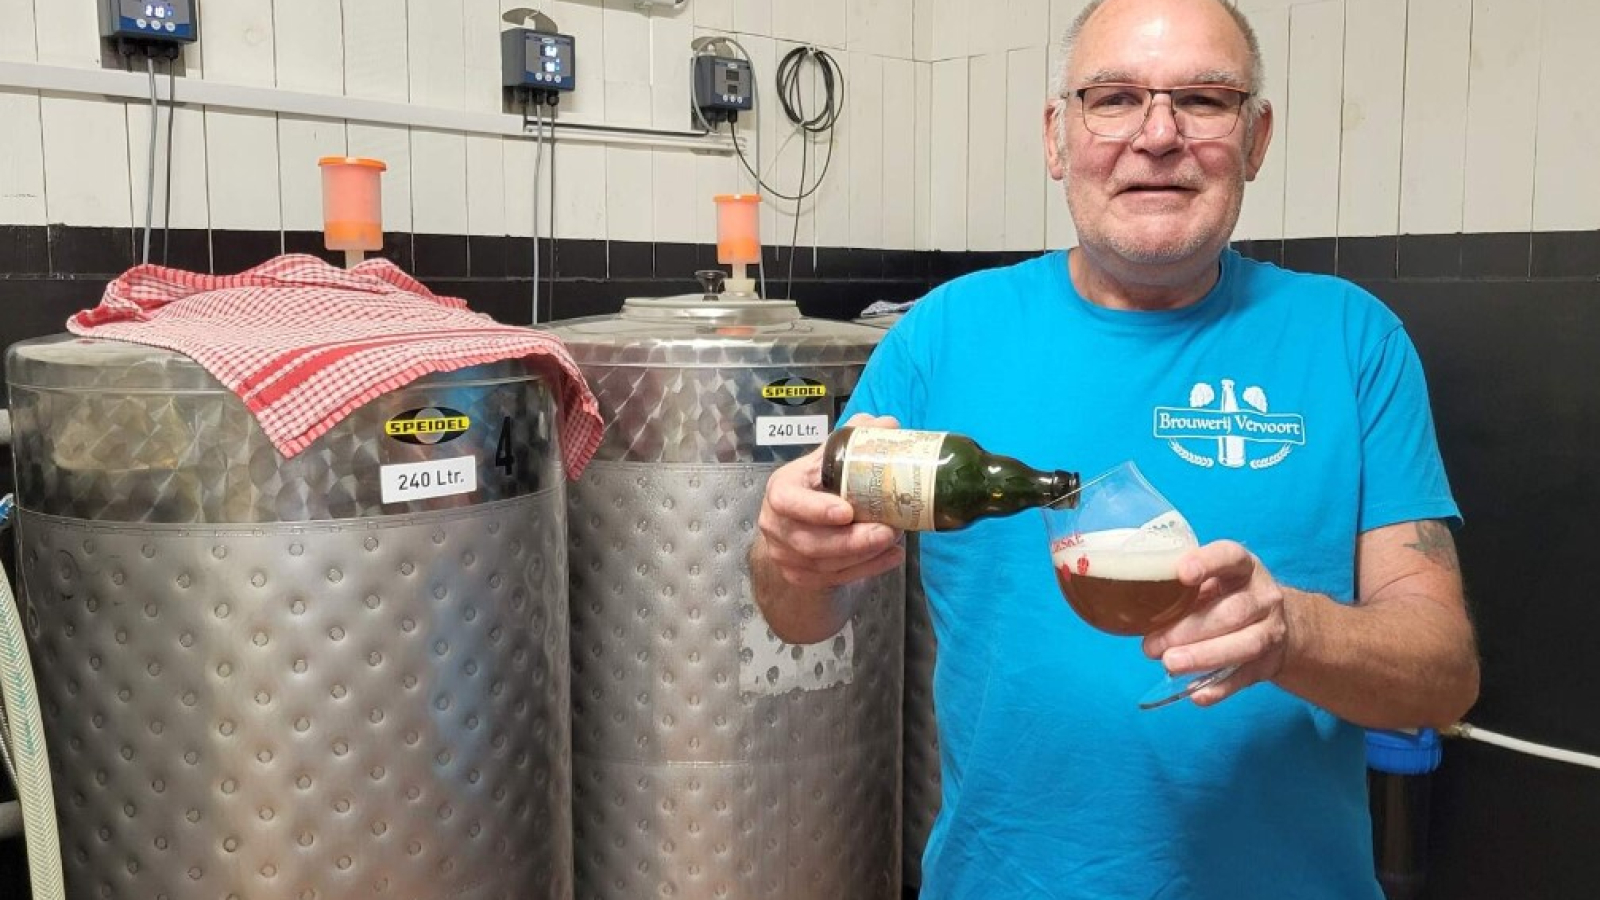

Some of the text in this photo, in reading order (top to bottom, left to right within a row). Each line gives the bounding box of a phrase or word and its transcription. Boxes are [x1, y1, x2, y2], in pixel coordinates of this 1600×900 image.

[765, 386, 825, 397] SPEIDEL
[390, 419, 468, 433] SPEIDEL
[768, 424, 819, 437] 240 Ltr.
[1159, 412, 1301, 435] Brouwerij Vervoort
[495, 416, 514, 476] 4
[398, 469, 465, 491] 240 Ltr.
